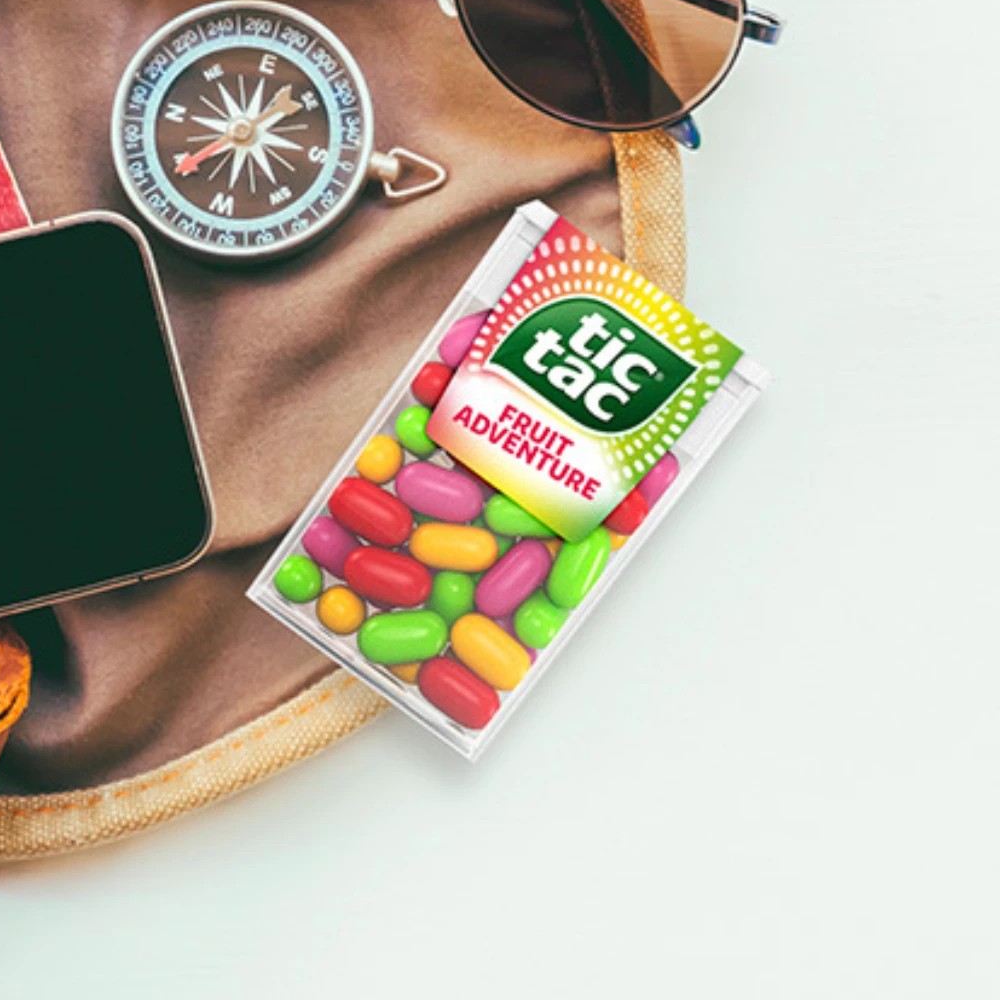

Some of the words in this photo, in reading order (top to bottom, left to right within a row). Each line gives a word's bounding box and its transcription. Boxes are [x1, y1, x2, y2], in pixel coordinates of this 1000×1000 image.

[207, 17, 234, 36] 240
[244, 17, 272, 35] 260
[173, 29, 199, 53] 220
[144, 54, 169, 80] 200
[258, 53, 278, 75] E
[164, 102, 187, 123] N
[308, 146, 329, 164] S
[568, 312, 657, 393] tic
[522, 328, 631, 422] tac
[498, 404, 575, 457] FRUIT
[452, 405, 602, 501] ADVENTURE
